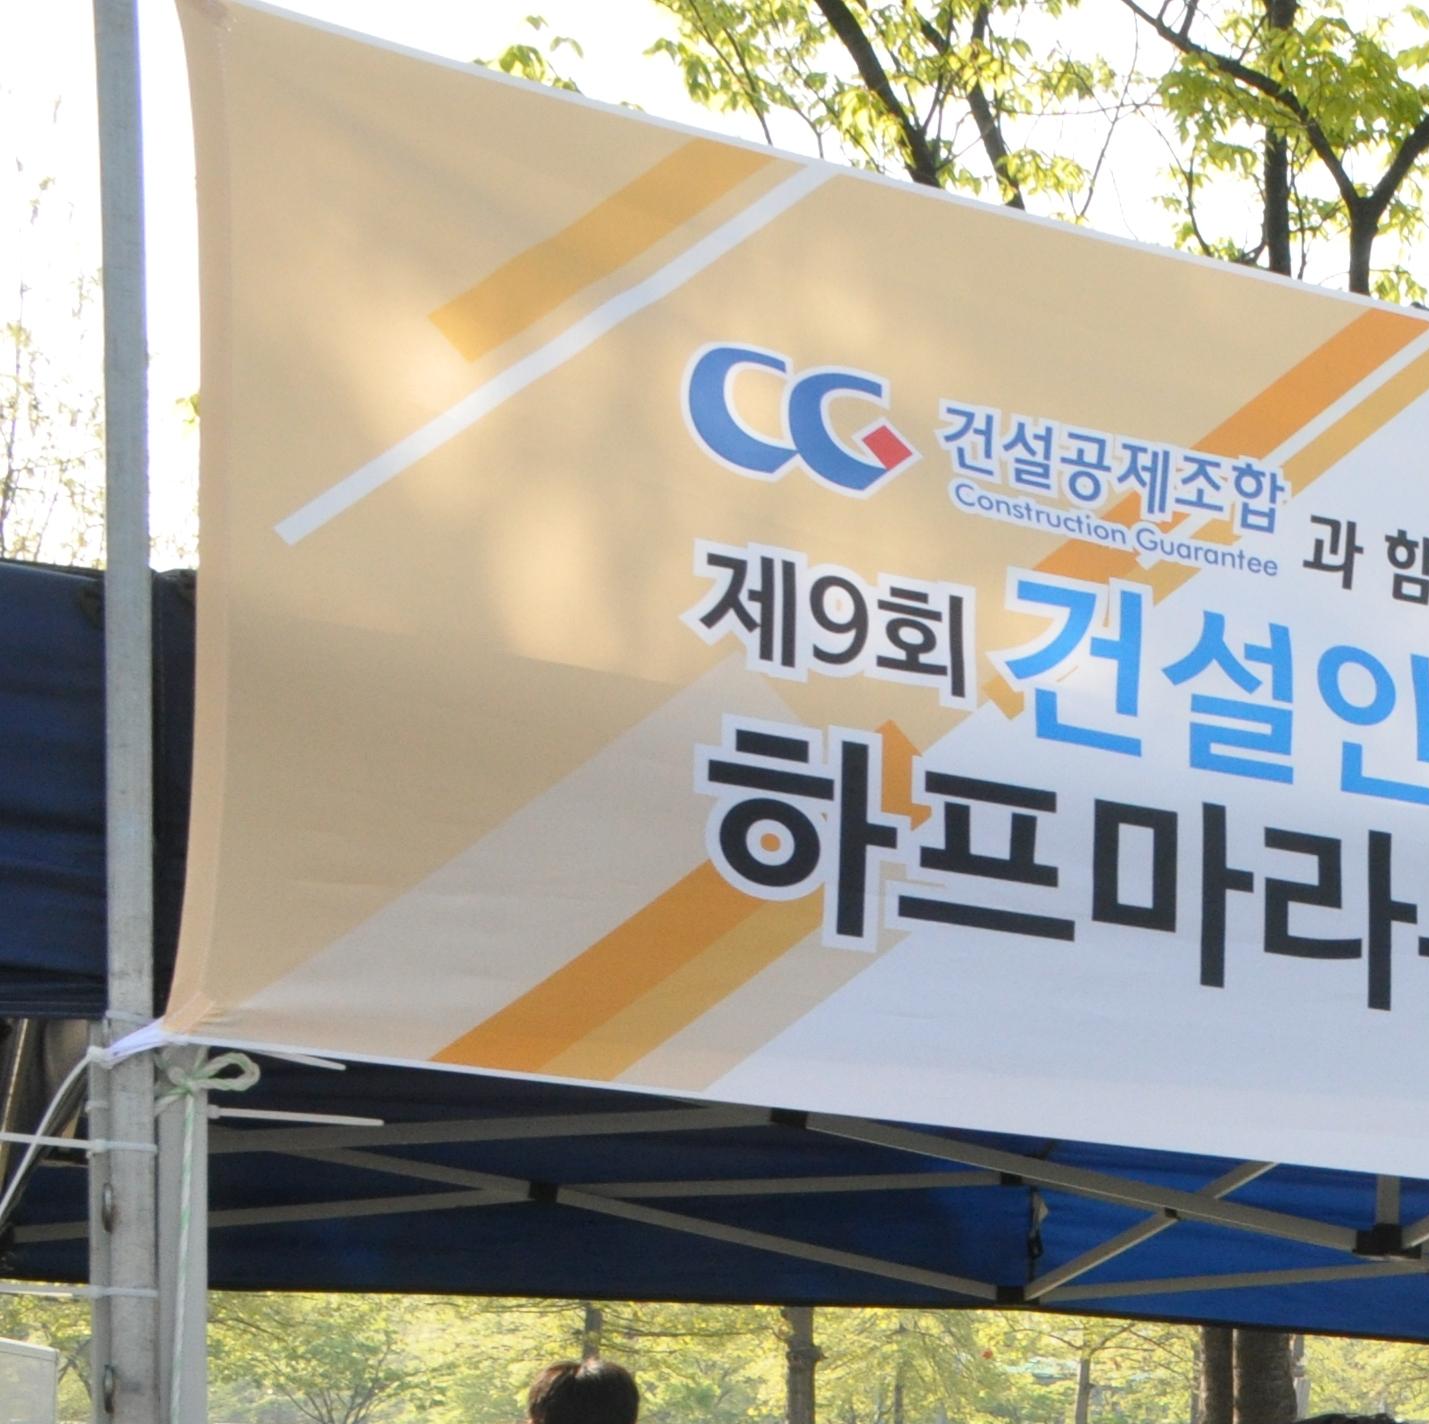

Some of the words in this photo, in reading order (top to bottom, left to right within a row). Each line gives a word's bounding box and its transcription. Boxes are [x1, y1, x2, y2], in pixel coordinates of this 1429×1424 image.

[944, 406, 1285, 534] 건설공제조합
[1303, 514, 1363, 590] 과
[954, 482, 1127, 545] Construction
[1136, 527, 1278, 577] Guarantee
[699, 549, 969, 699] 제9회
